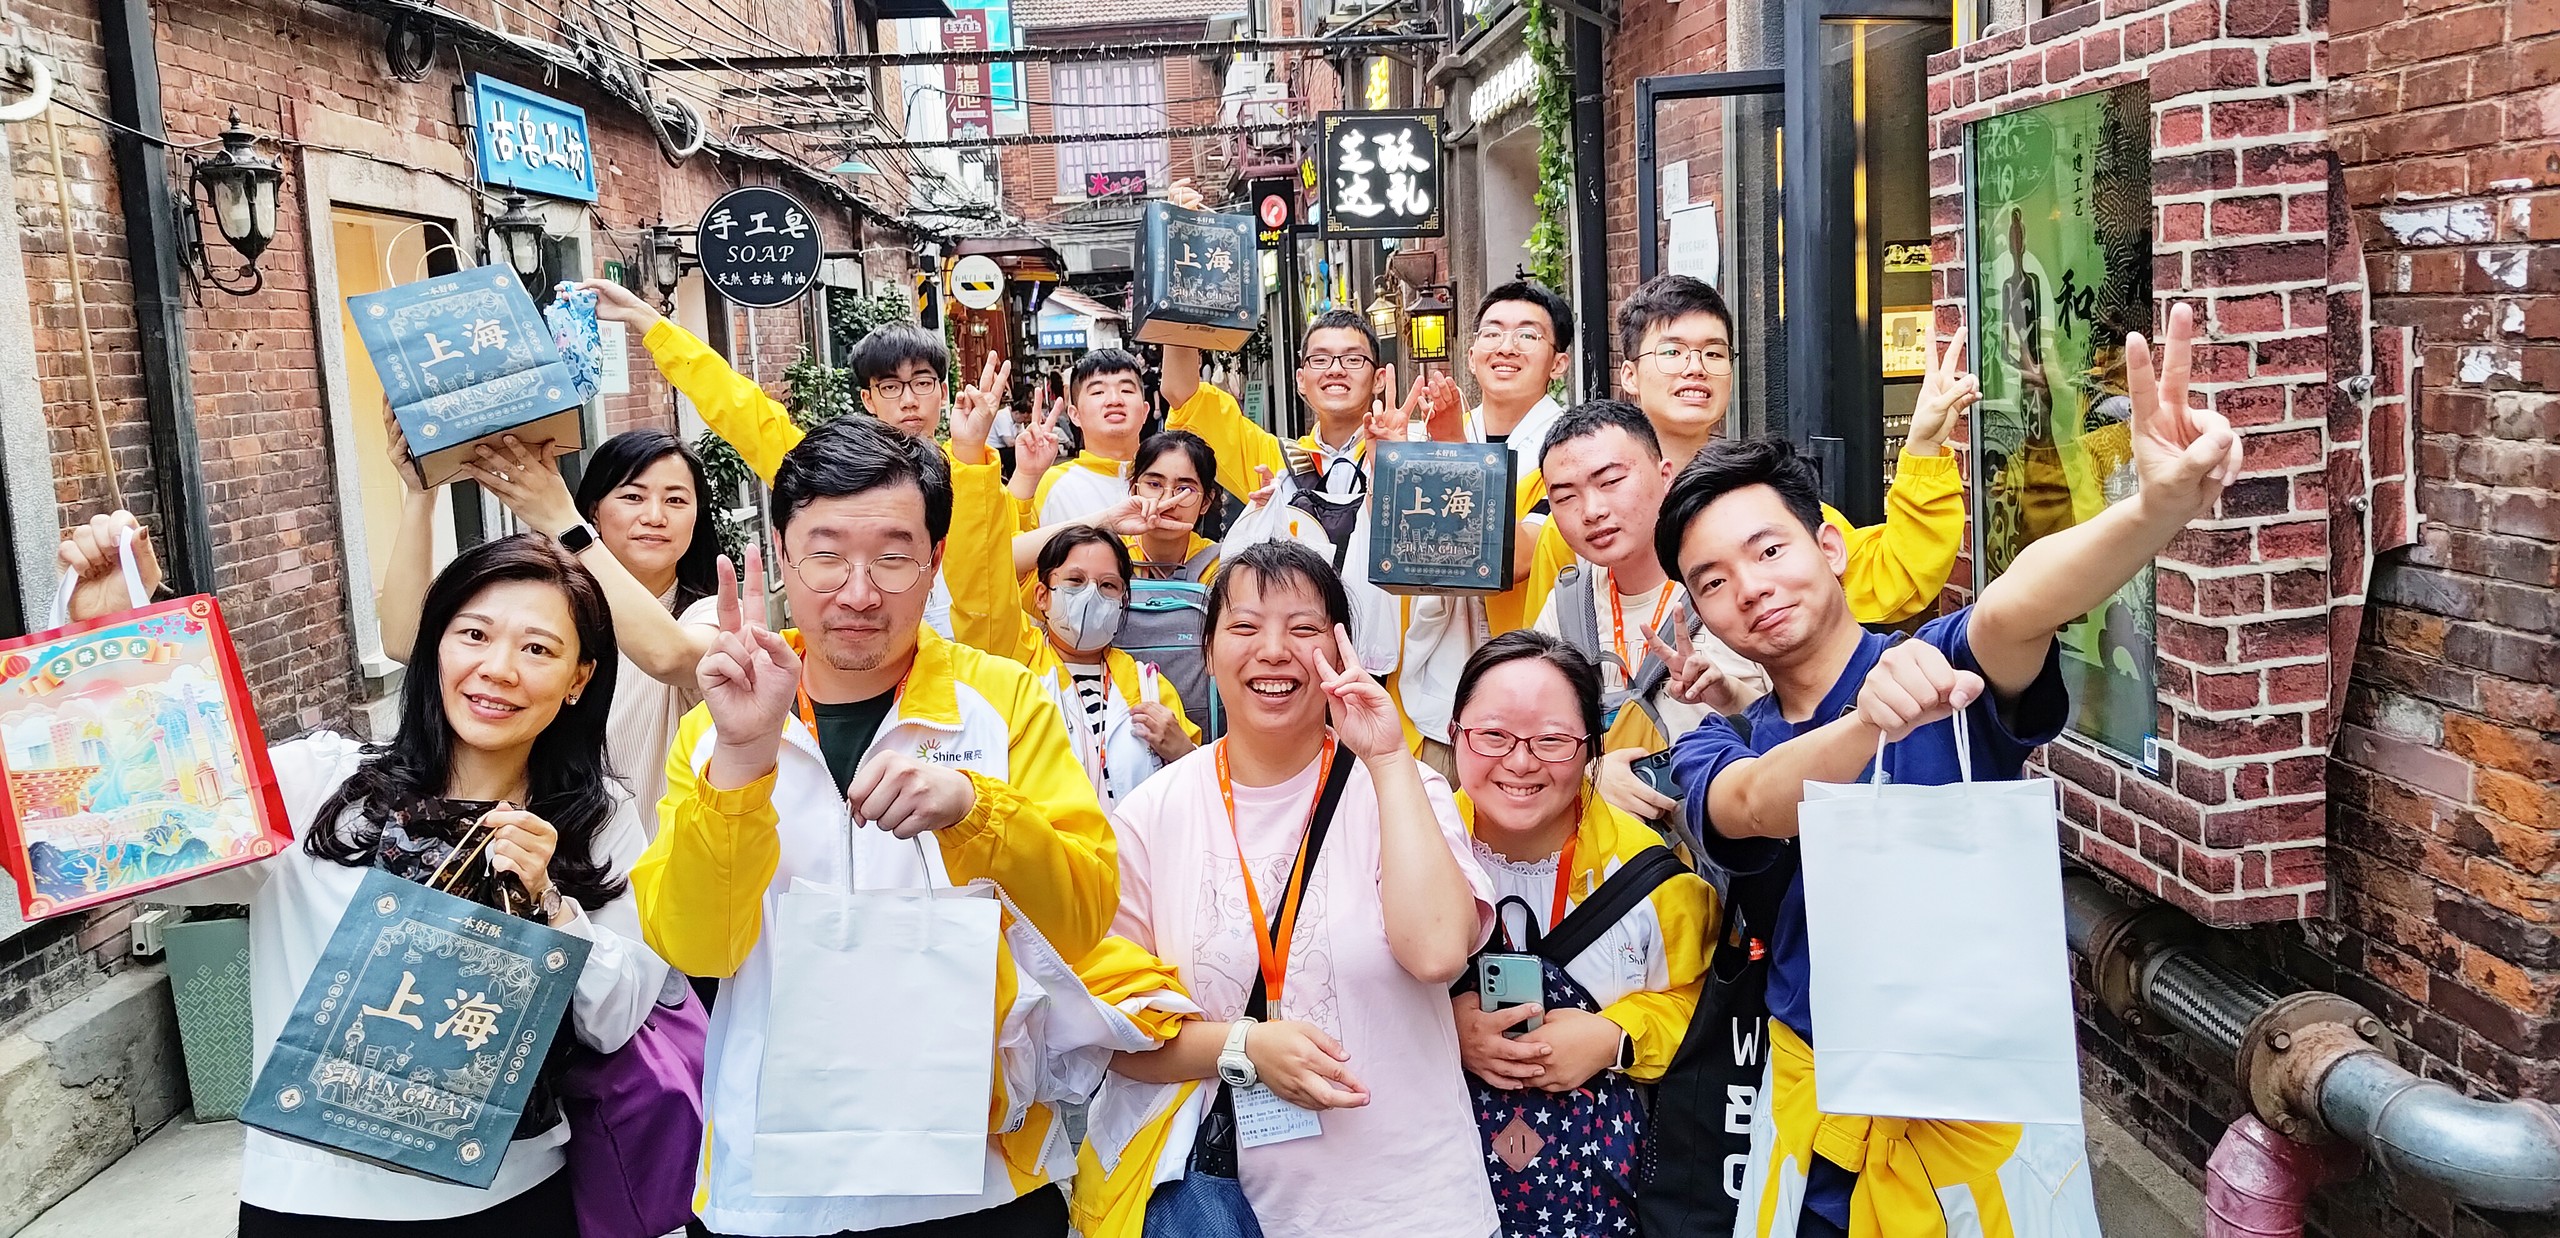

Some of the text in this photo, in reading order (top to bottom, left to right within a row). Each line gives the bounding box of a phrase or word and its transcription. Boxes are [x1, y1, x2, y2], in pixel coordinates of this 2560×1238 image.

[487, 100, 585, 181] 古皂工坊
[708, 207, 809, 240] 手工皂
[727, 245, 795, 263] SOAP
[1174, 243, 1233, 273] 上海
[718, 271, 806, 286] 天然 古法 精油
[1171, 286, 1238, 302] SHANGHAI
[2054, 268, 2096, 340] 和
[418, 318, 510, 369] 上海
[430, 373, 538, 415] SHANGHAI
[1401, 486, 1476, 519] 上海
[1396, 543, 1477, 556] SHANGHAI
[932, 751, 962, 763] Shine
[382, 900, 392, 910] 上
[447, 915, 503, 939] 一本好酥
[362, 970, 504, 1051] 上海
[1733, 1016, 1767, 1066] W
[323, 1061, 474, 1120] SHANGHAI
